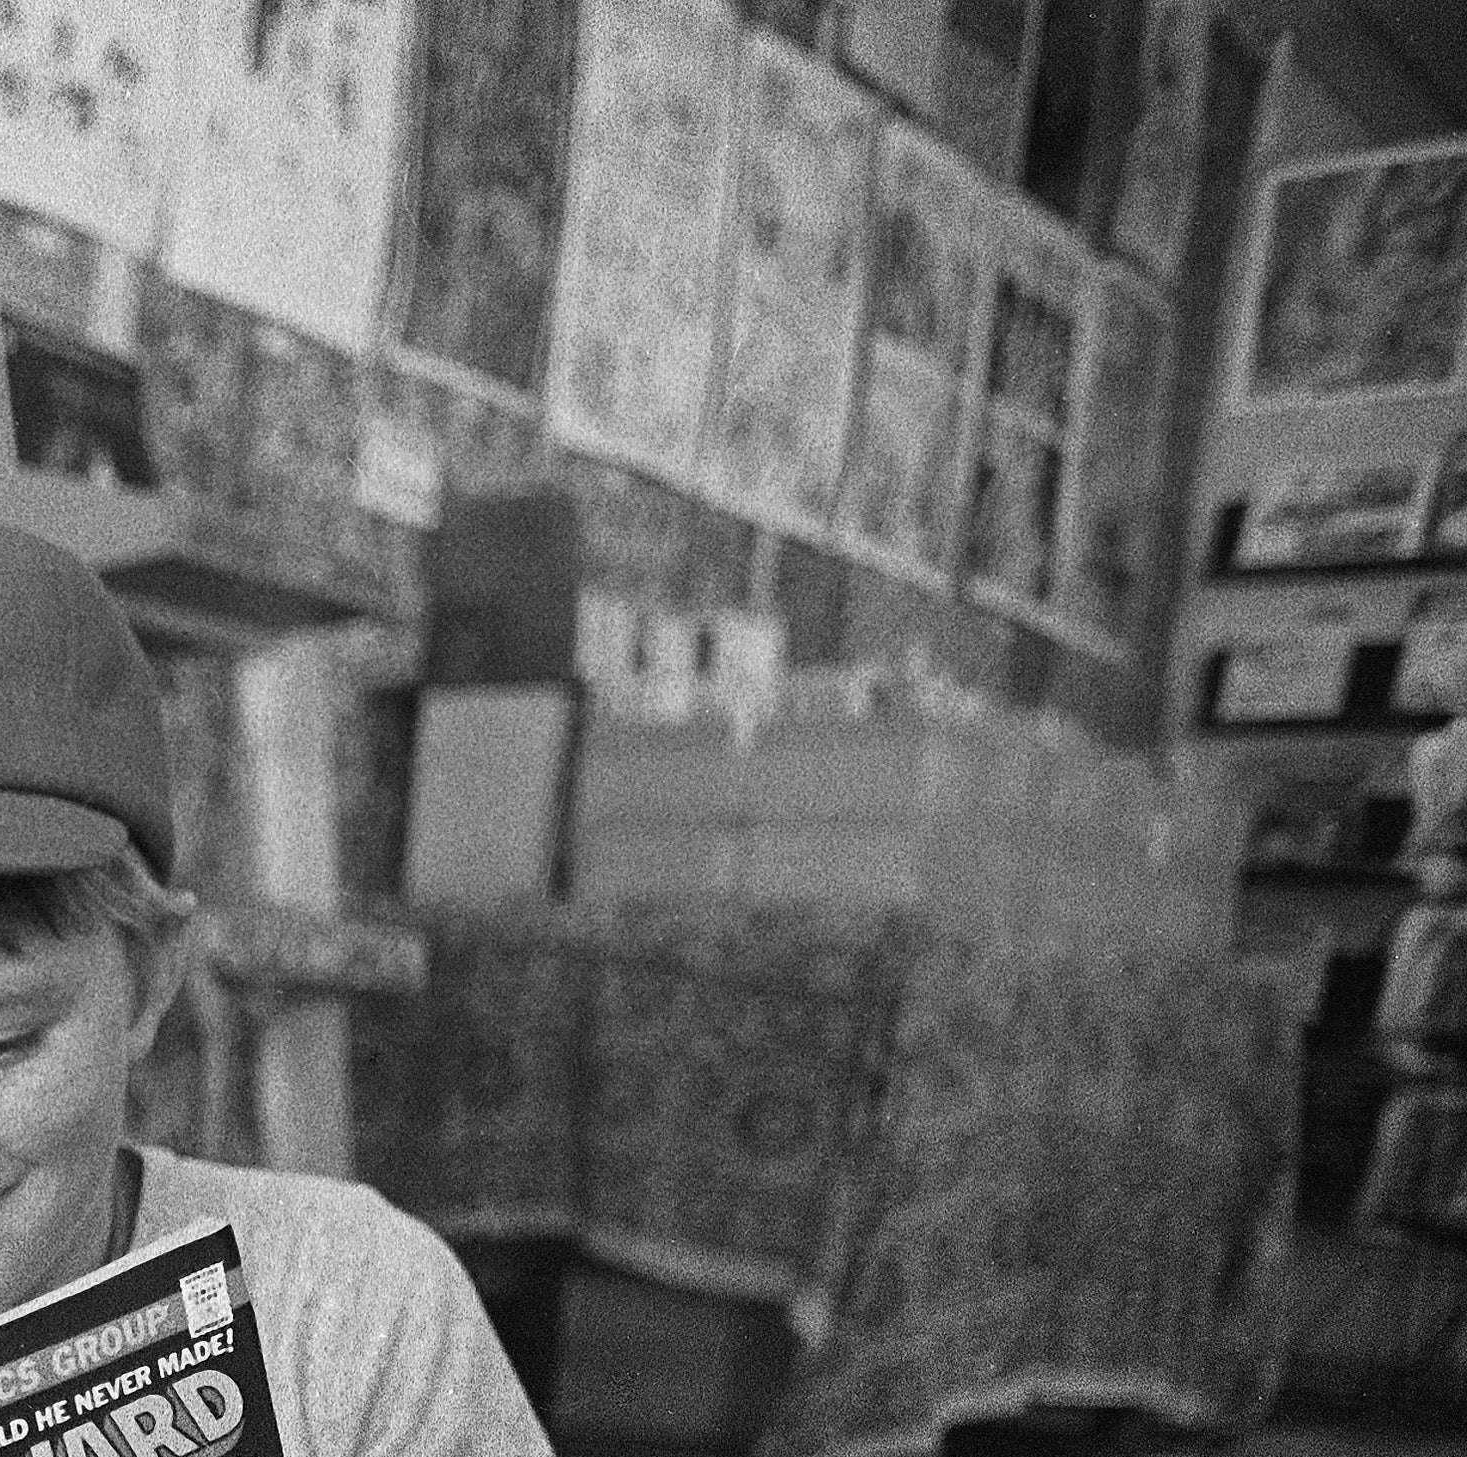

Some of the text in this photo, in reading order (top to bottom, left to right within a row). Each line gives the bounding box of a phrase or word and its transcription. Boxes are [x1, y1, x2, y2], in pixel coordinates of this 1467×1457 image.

[34, 1404, 71, 1434] HE
[72, 1364, 153, 1420] NEVER
[156, 1327, 236, 1381] MADE!
[51, 1304, 168, 1379] GROUP
